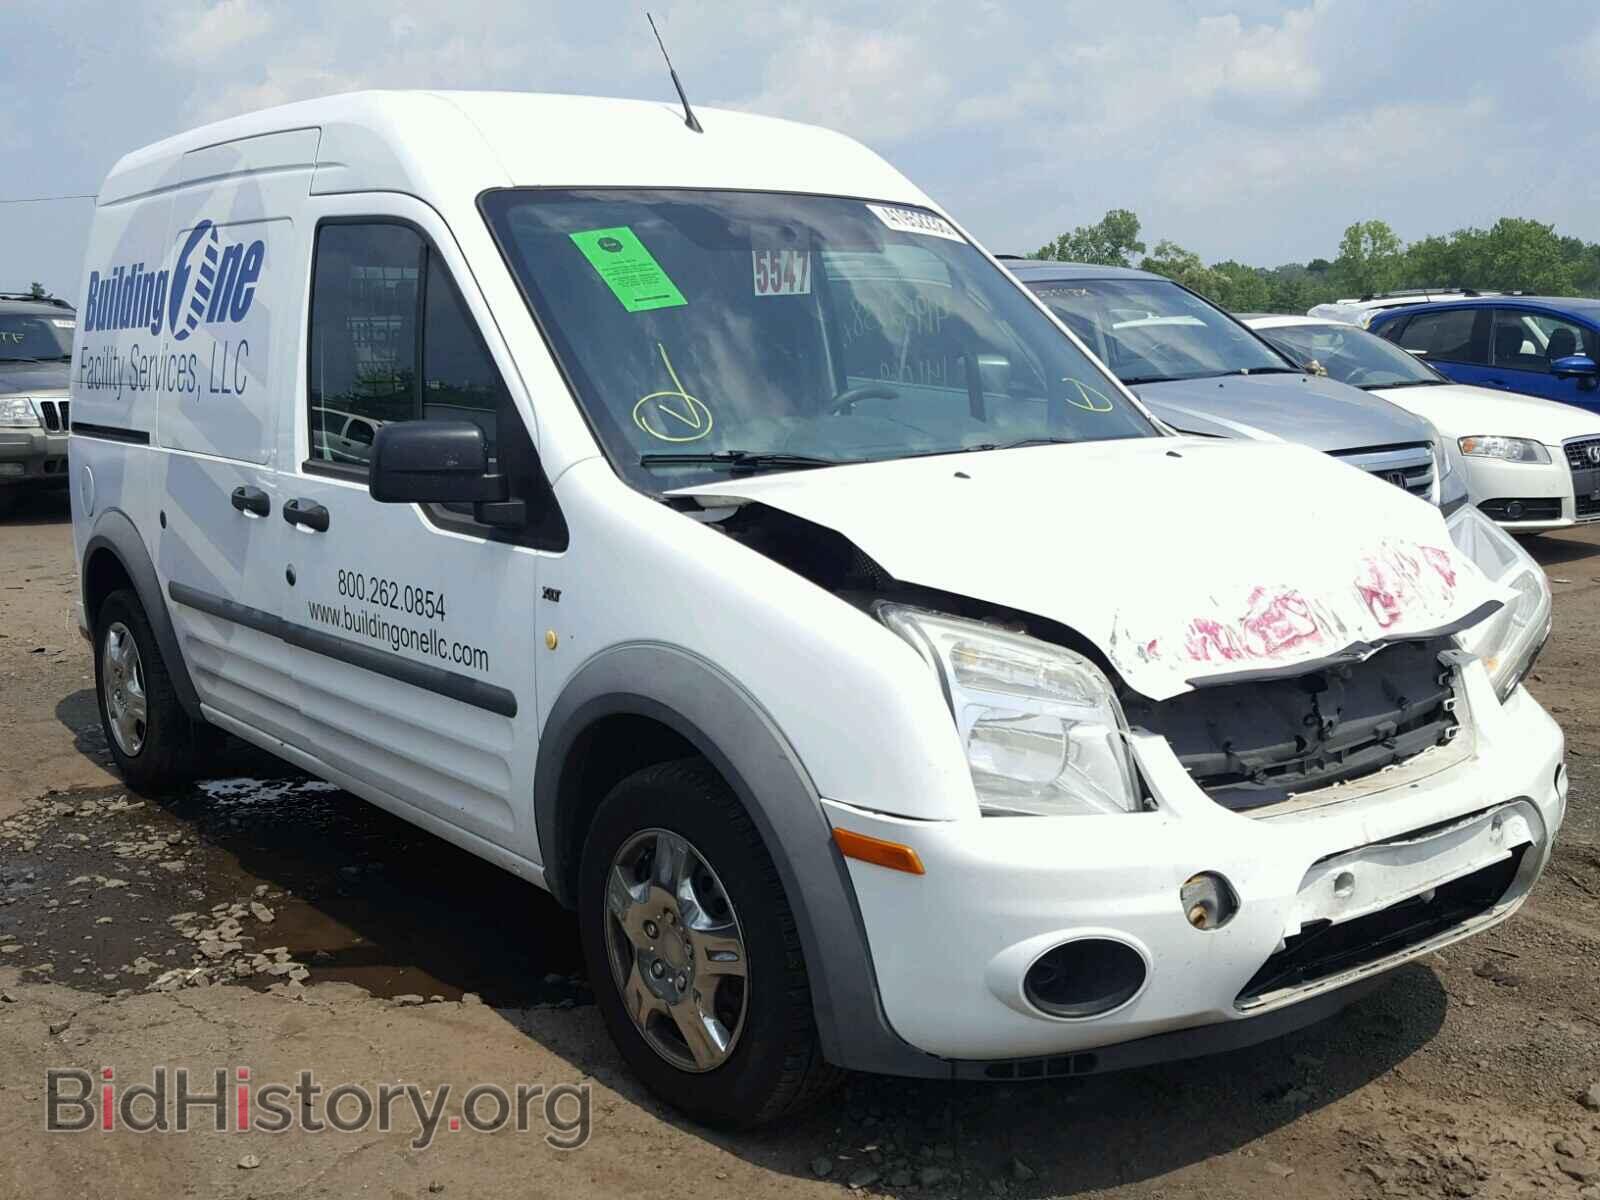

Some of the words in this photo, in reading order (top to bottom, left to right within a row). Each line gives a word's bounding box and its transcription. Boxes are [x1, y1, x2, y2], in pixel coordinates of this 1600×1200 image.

[755, 250, 808, 293] 5547
[80, 346, 126, 400] Facility
[129, 343, 201, 402] Services,
[209, 339, 249, 395] LLC
[338, 569, 446, 622] 800.262.0854
[308, 600, 489, 672] www.buildingonellc.com
